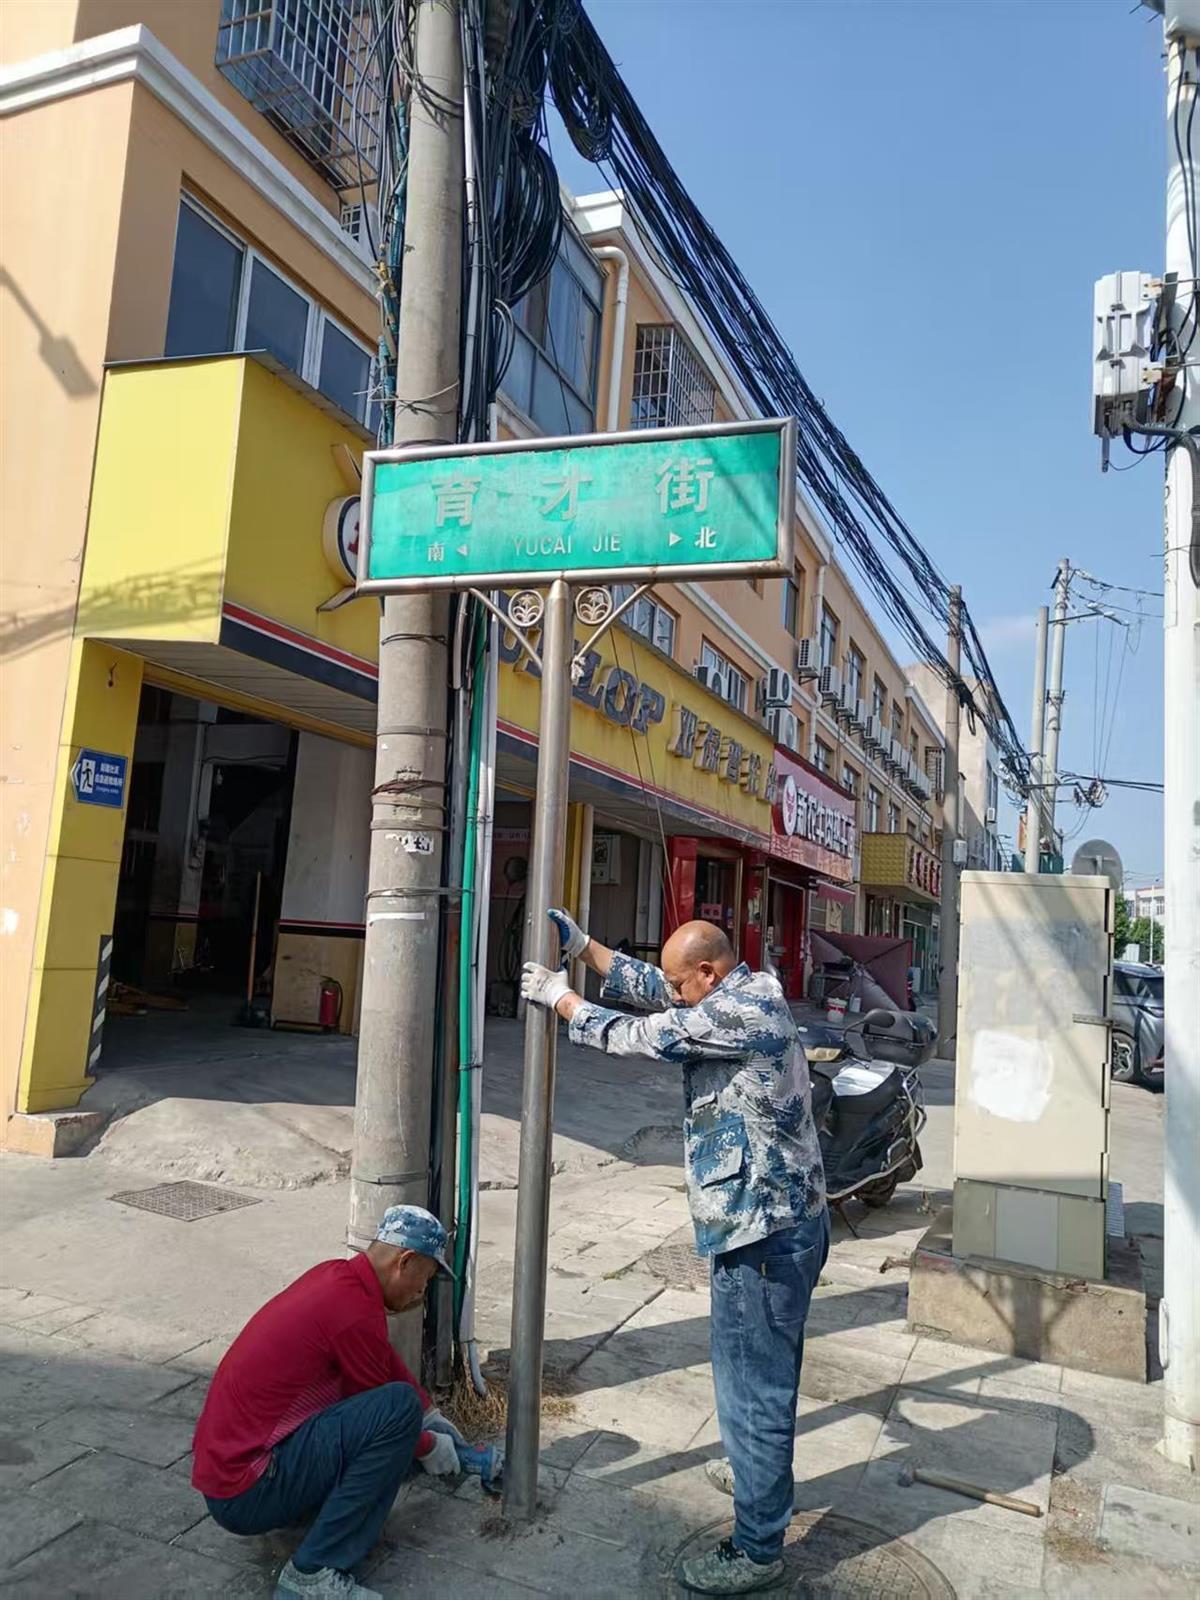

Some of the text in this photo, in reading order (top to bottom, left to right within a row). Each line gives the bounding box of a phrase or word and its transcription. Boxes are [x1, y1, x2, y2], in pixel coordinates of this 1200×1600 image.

[430, 459, 713, 528] 育才街
[513, 533, 619, 555] YUCAI JIE
[694, 526, 716, 548] 北
[428, 543, 443, 562] 南
